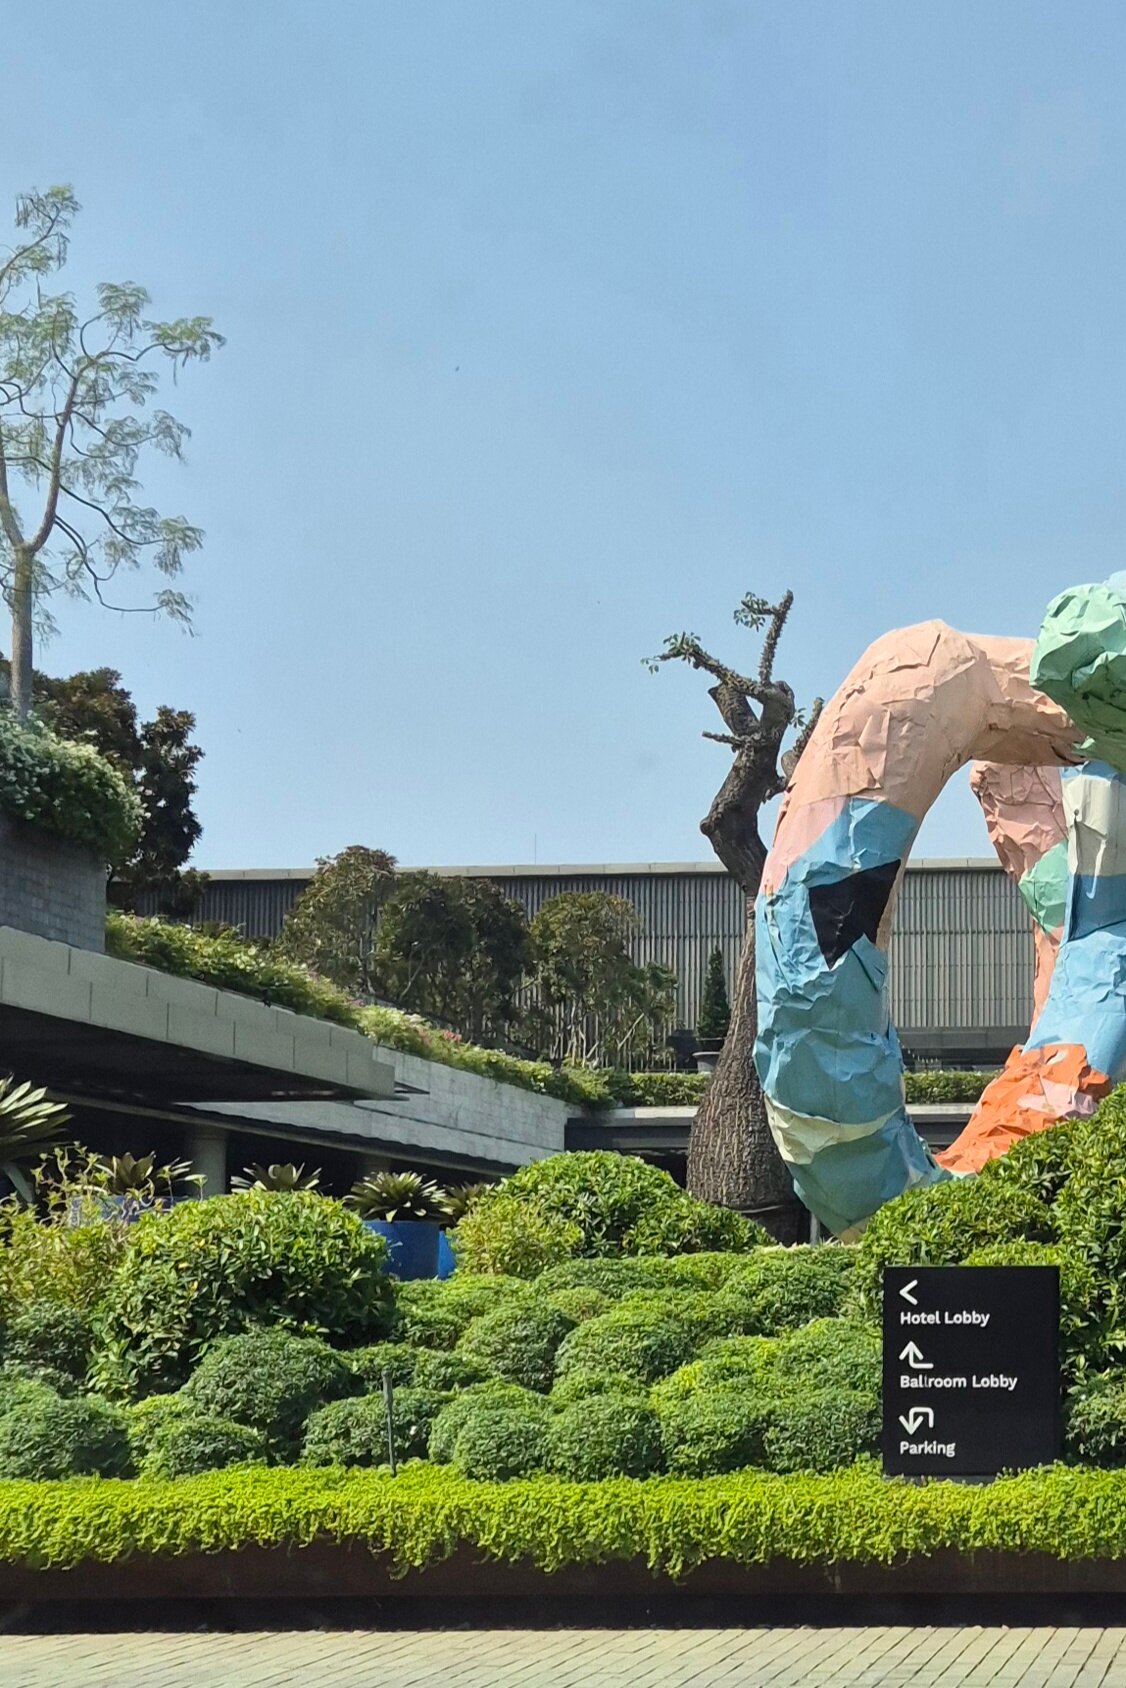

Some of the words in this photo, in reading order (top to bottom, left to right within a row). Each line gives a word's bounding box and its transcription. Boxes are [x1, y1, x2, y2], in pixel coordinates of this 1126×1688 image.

[900, 1311, 941, 1325] Hotel
[944, 1311, 990, 1327] Lobby
[900, 1375, 967, 1388] Ballroom
[972, 1374, 1018, 1391] Lobby
[900, 1441, 956, 1457] Parking
